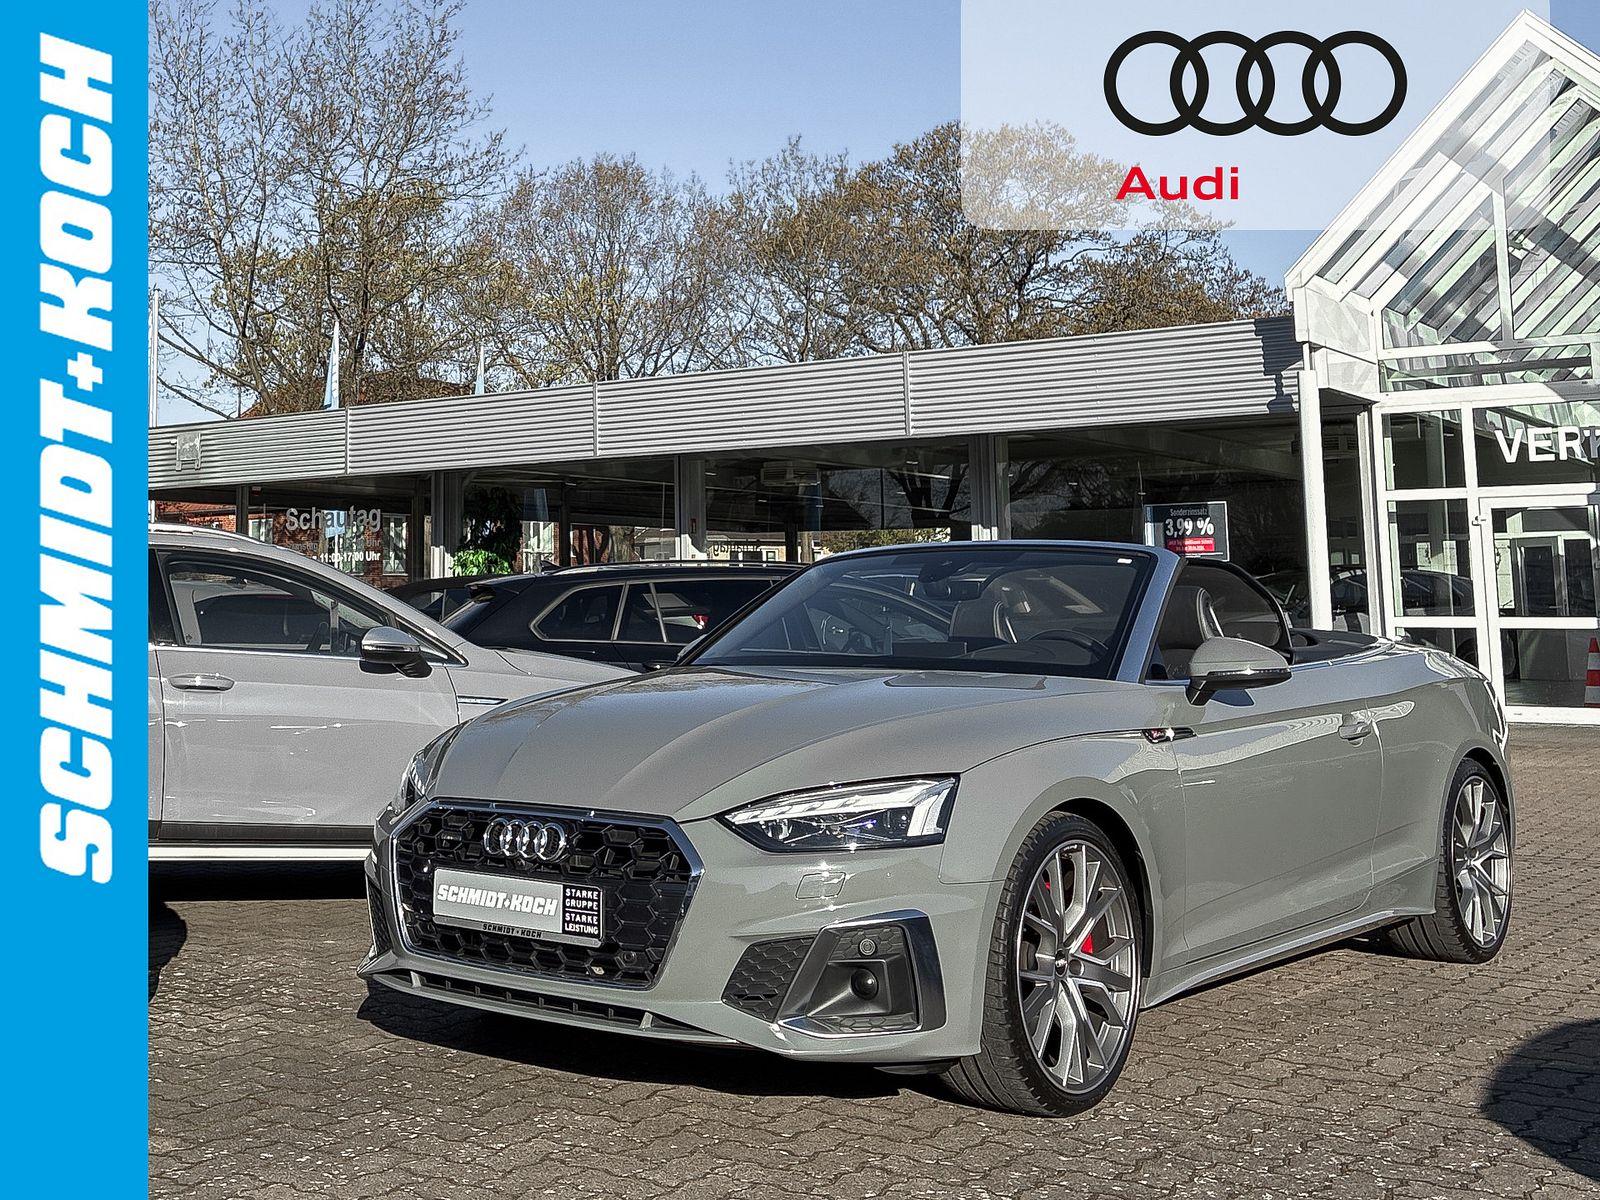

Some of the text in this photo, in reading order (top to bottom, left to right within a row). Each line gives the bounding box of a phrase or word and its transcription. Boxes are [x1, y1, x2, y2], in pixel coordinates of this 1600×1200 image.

[285, 505, 381, 532] Schautag
[1165, 517, 1215, 538] 3,99 %
[365, 551, 381, 561] Uhr
[565, 888, 599, 900] STARKE
[565, 899, 599, 910] GRUPPE
[564, 912, 598, 925] STARKE
[564, 922, 599, 935] LEISTUNG
